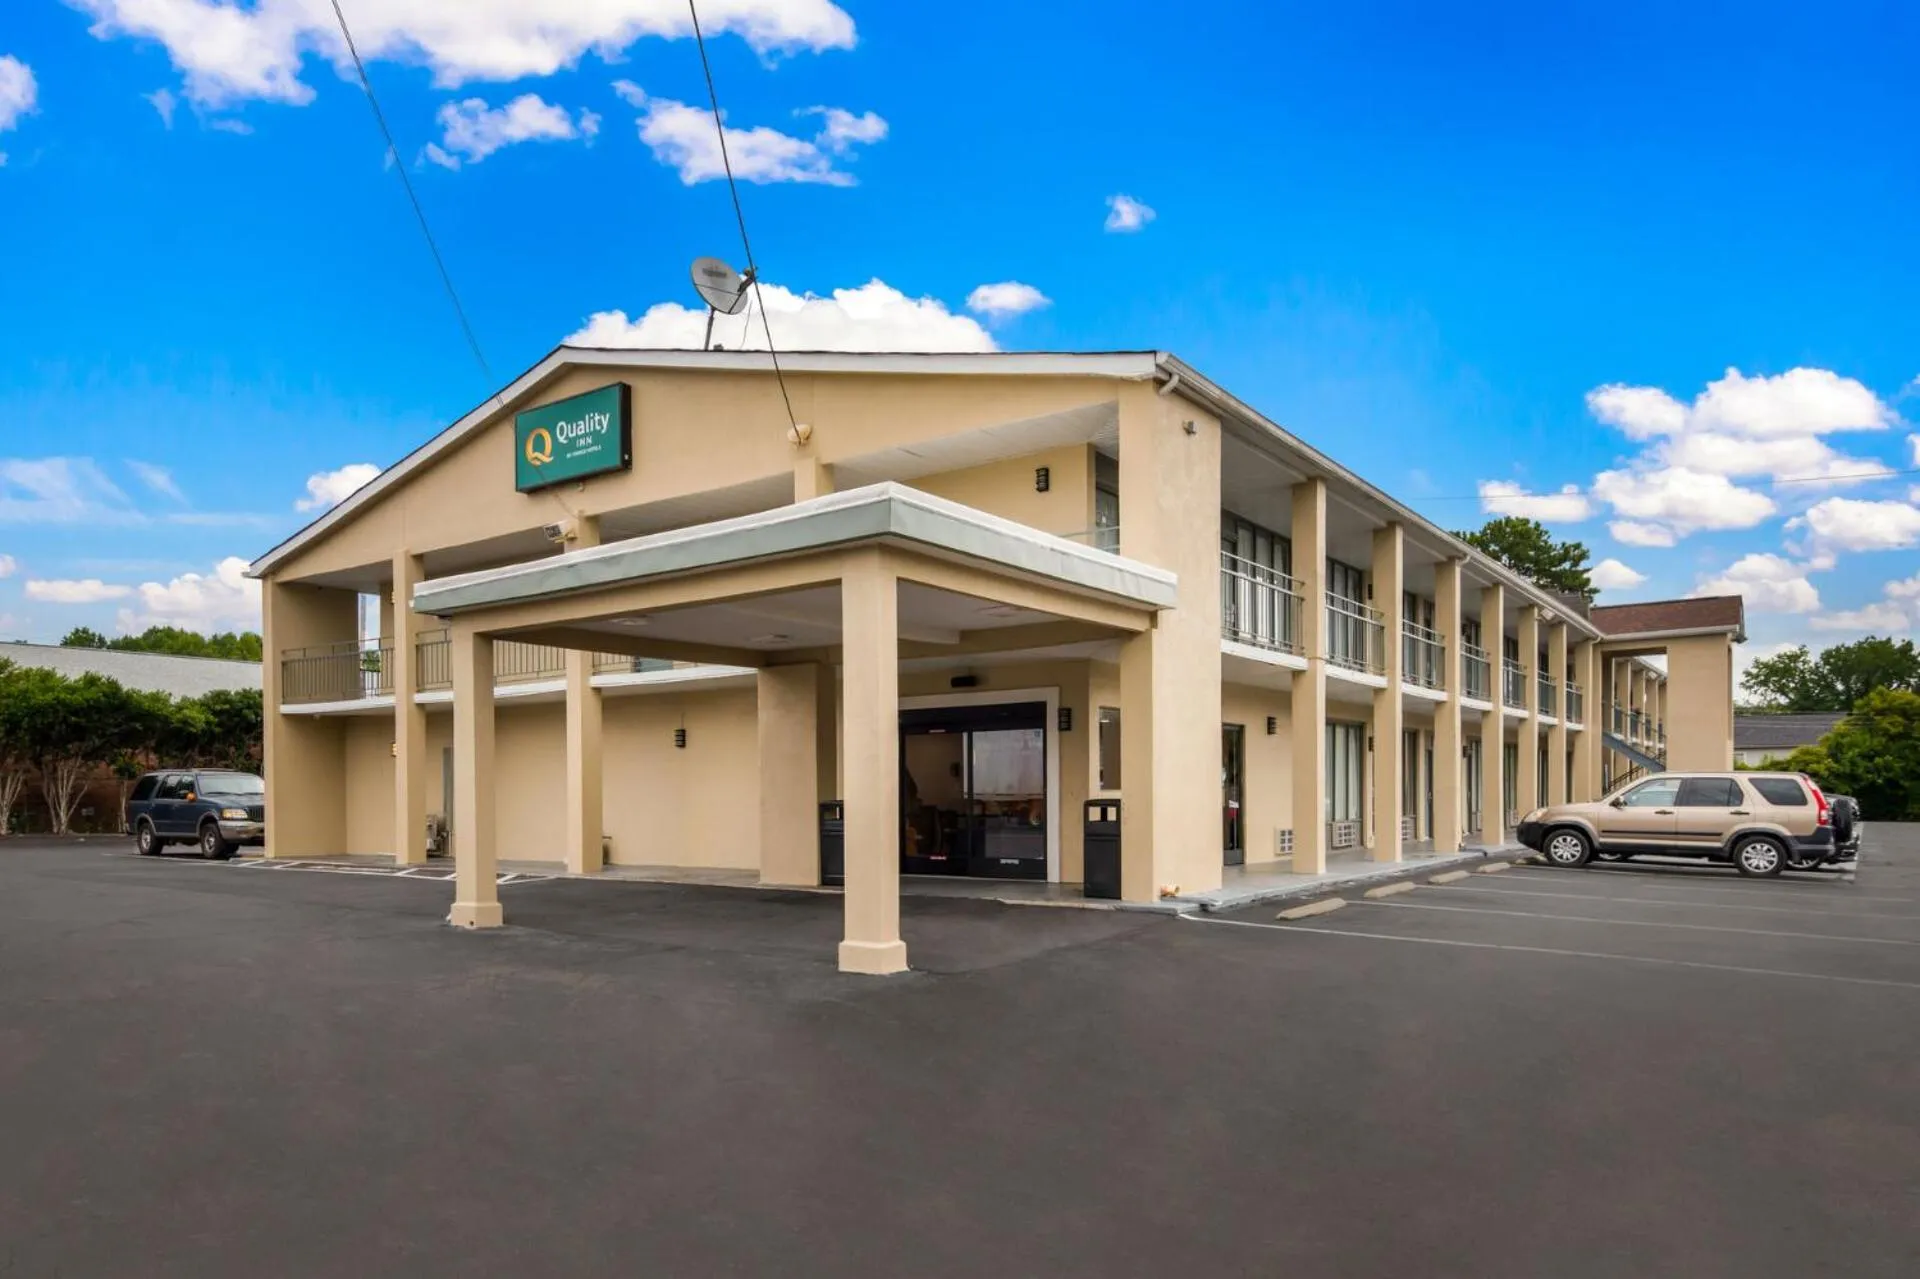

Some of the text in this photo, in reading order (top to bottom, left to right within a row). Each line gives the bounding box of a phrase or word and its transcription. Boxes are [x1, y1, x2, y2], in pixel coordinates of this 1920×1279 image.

[556, 413, 609, 443] Quality
[576, 435, 592, 448] INN
[525, 428, 554, 466] Q
